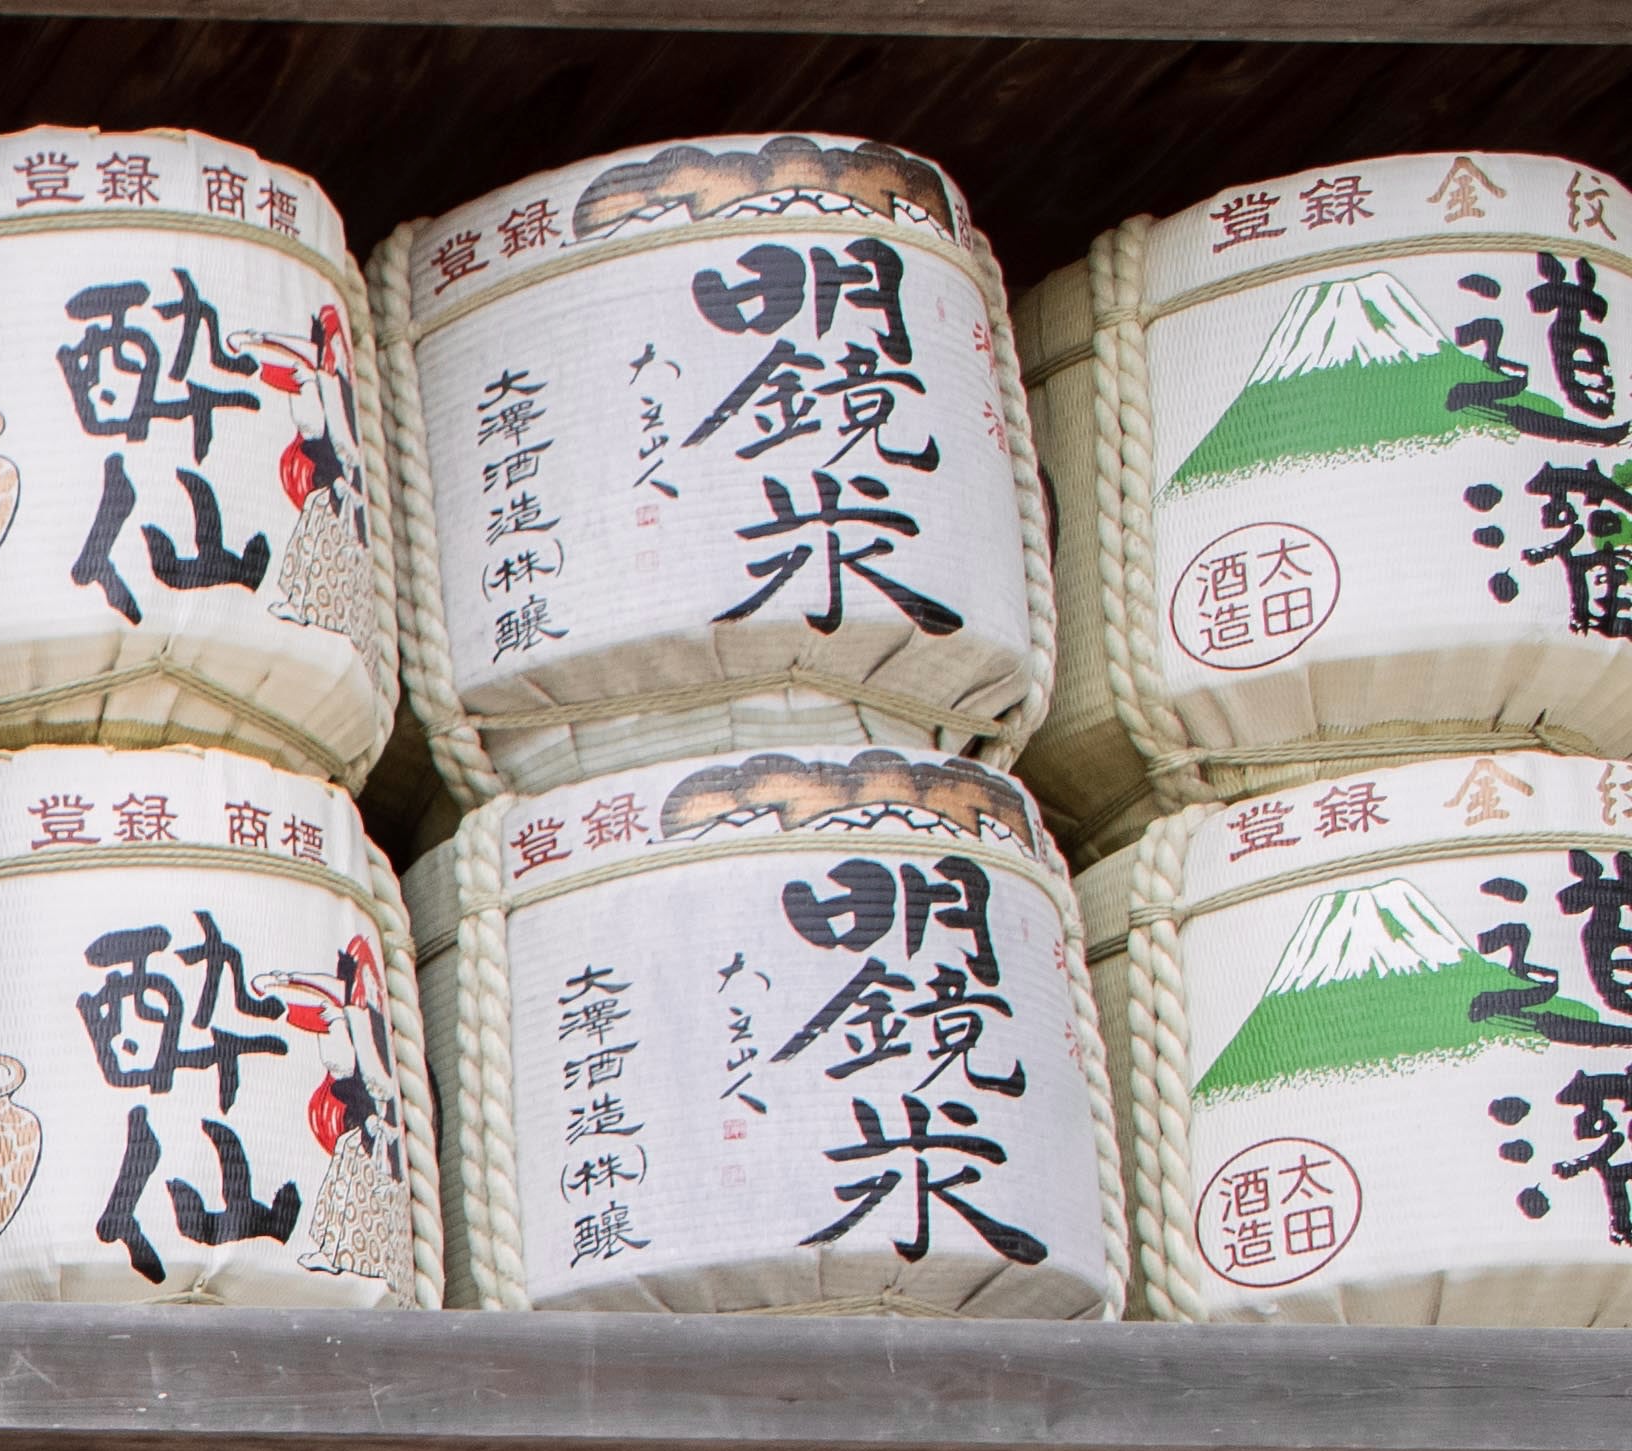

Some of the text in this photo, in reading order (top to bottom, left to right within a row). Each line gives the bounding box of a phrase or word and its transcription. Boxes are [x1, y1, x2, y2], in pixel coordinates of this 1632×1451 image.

[14, 151, 161, 208] 登録
[1210, 156, 1617, 253] 登録 金紋
[431, 199, 561, 295] 登録
[56, 267, 271, 626] 酔仙
[28, 794, 179, 850] 登録
[509, 792, 650, 879] 登録
[1228, 781, 1389, 861] 登録
[76, 910, 303, 1285] 酔仙
